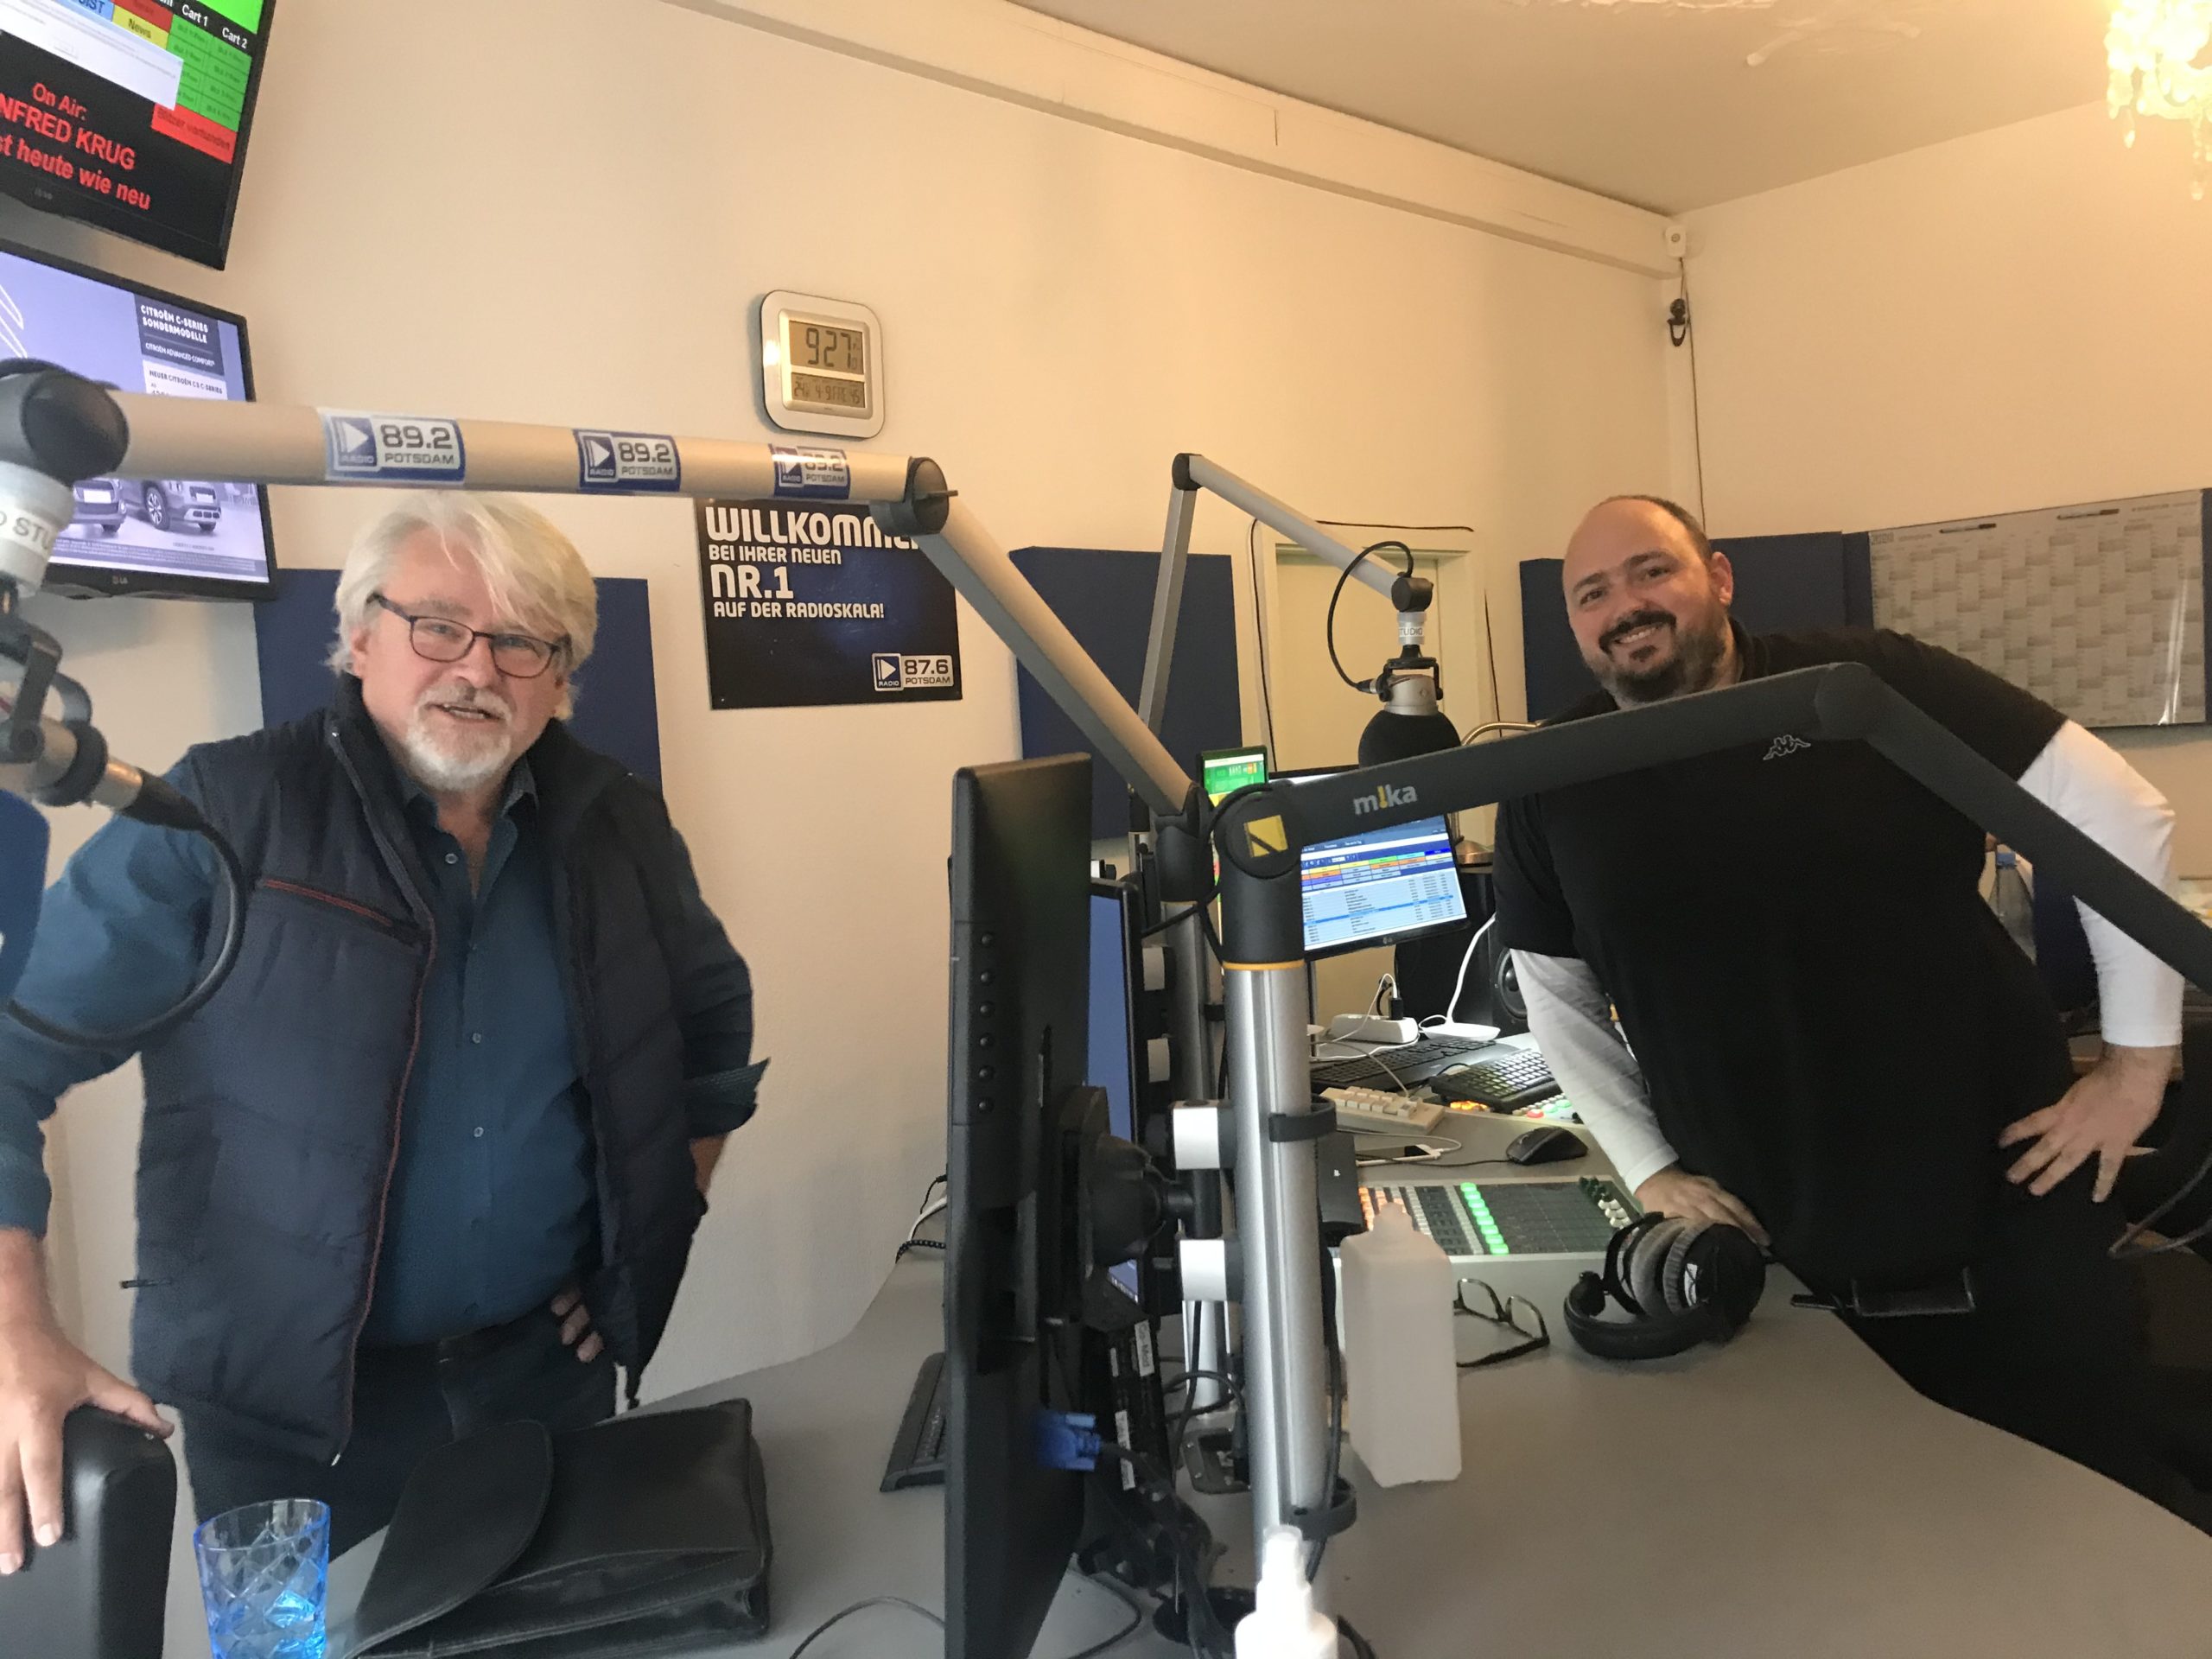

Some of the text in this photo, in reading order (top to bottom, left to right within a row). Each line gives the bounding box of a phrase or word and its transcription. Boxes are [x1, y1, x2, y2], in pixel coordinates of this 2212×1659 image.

[182, 3, 202, 23] Cart
[203, 16, 209, 27] 1
[128, 18, 151, 39] News
[222, 27, 244, 47] Cart
[242, 38, 249, 49] 2
[33, 82, 87, 121] On Air:
[75, 127, 137, 170] KRUG
[16, 138, 74, 180] heute
[79, 168, 111, 194] wie
[116, 183, 151, 210] neu
[141, 304, 208, 333] CITROËN C-SERIES
[143, 316, 207, 344] SONDERMODELLE
[149, 370, 168, 381] NEUER
[380, 424, 453, 450] 89.2
[385, 453, 454, 465] POTSDAM
[618, 442, 671, 462] 89.2
[621, 466, 673, 475] POTSDAM
[805, 474, 845, 483] POTSDAM
[708, 543, 842, 565] BEI IHRER NEUEN
[710, 563, 794, 599] NR.1
[714, 601, 885, 619] AUF DER RADIOSKALA!
[904, 659, 949, 675] 87.6
[905, 676, 950, 685] POTSDAM
